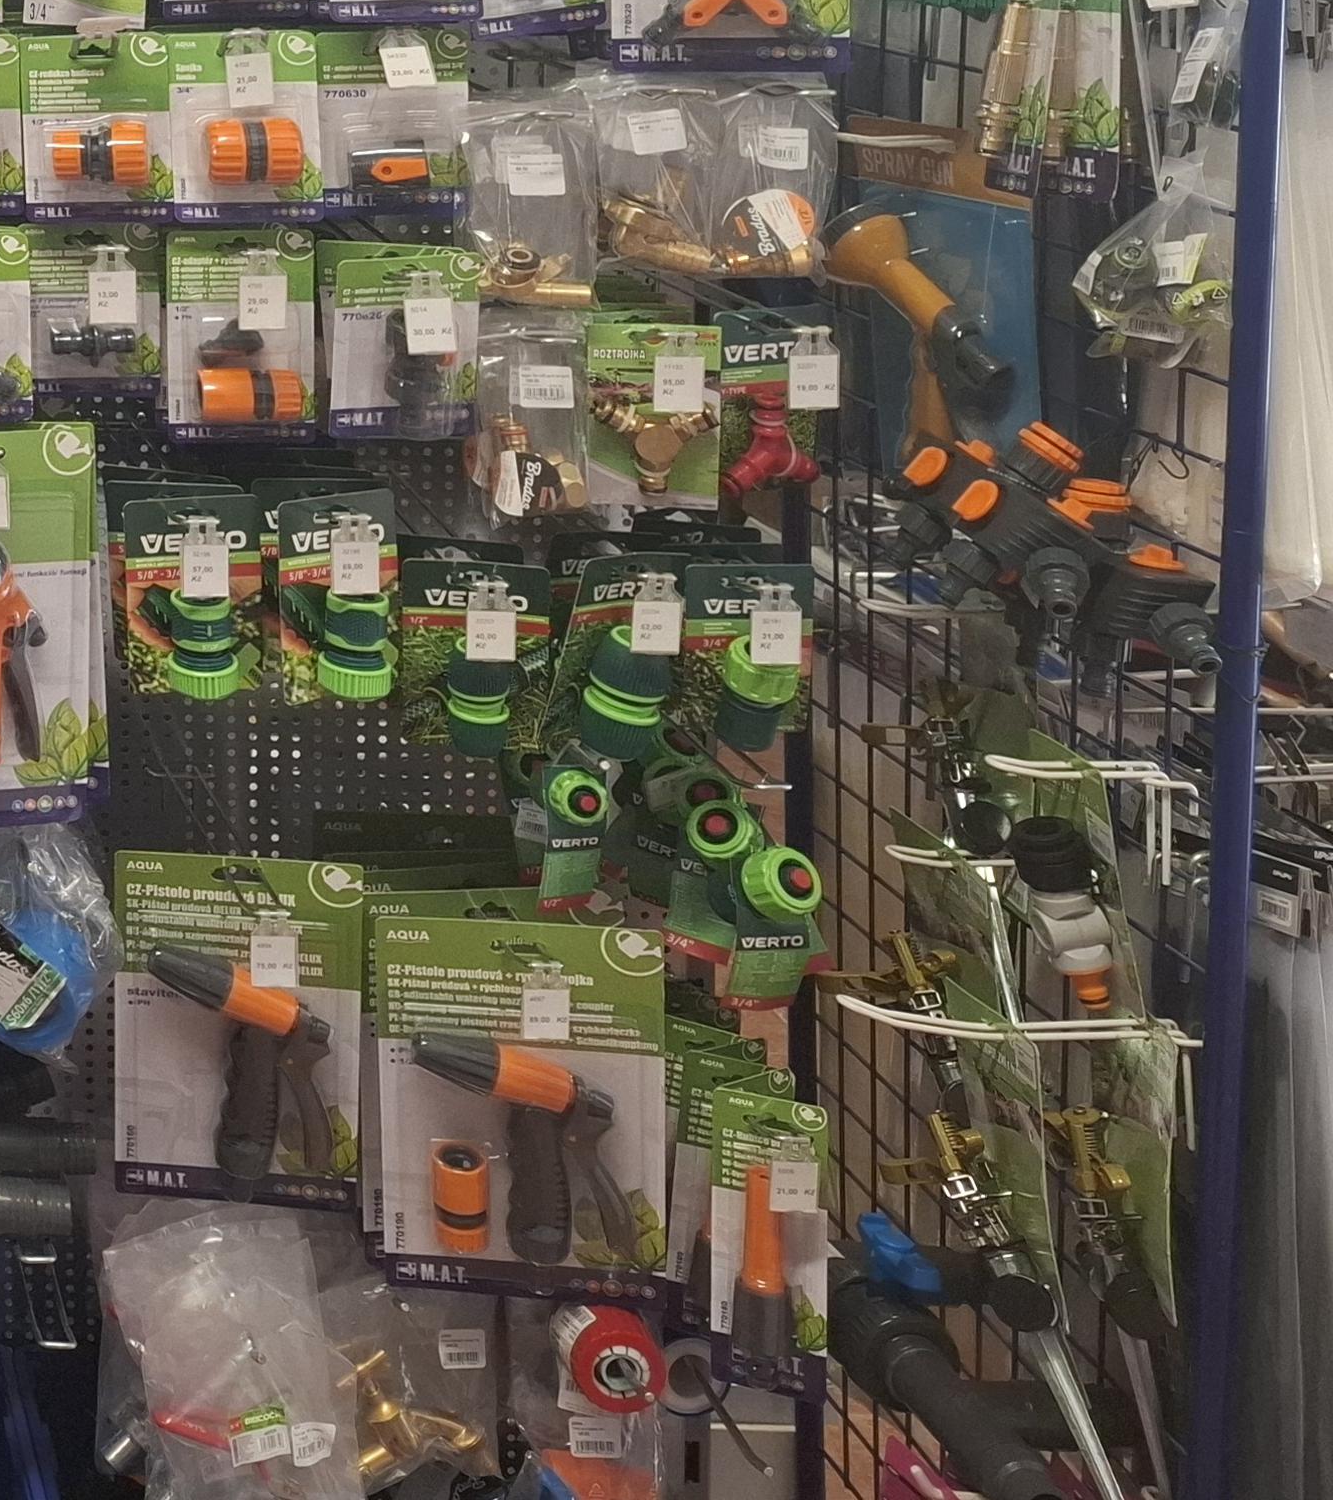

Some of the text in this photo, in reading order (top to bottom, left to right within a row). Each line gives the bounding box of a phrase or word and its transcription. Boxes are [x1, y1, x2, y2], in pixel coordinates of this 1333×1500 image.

[623, 3, 633, 37] 770520
[638, 47, 688, 67] M.A.T.
[323, 88, 368, 99] 770630
[864, 149, 916, 182] SPRAY
[756, 205, 784, 257] Bradas
[724, 341, 794, 363] VERT
[522, 461, 542, 512] Bradas
[551, 836, 599, 849] VERTO
[126, 860, 164, 872] AQUA
[126, 884, 188, 900] CZ-Pistole
[386, 930, 430, 942] AQUA
[741, 935, 804, 948] VERTO
[387, 963, 447, 979] CZ-Pistole
[126, 1124, 136, 1158] 770160
[146, 1170, 189, 1188] M.A.T.
[395, 1212, 405, 1250] 770190
[420, 1263, 469, 1283] M.A.T.
